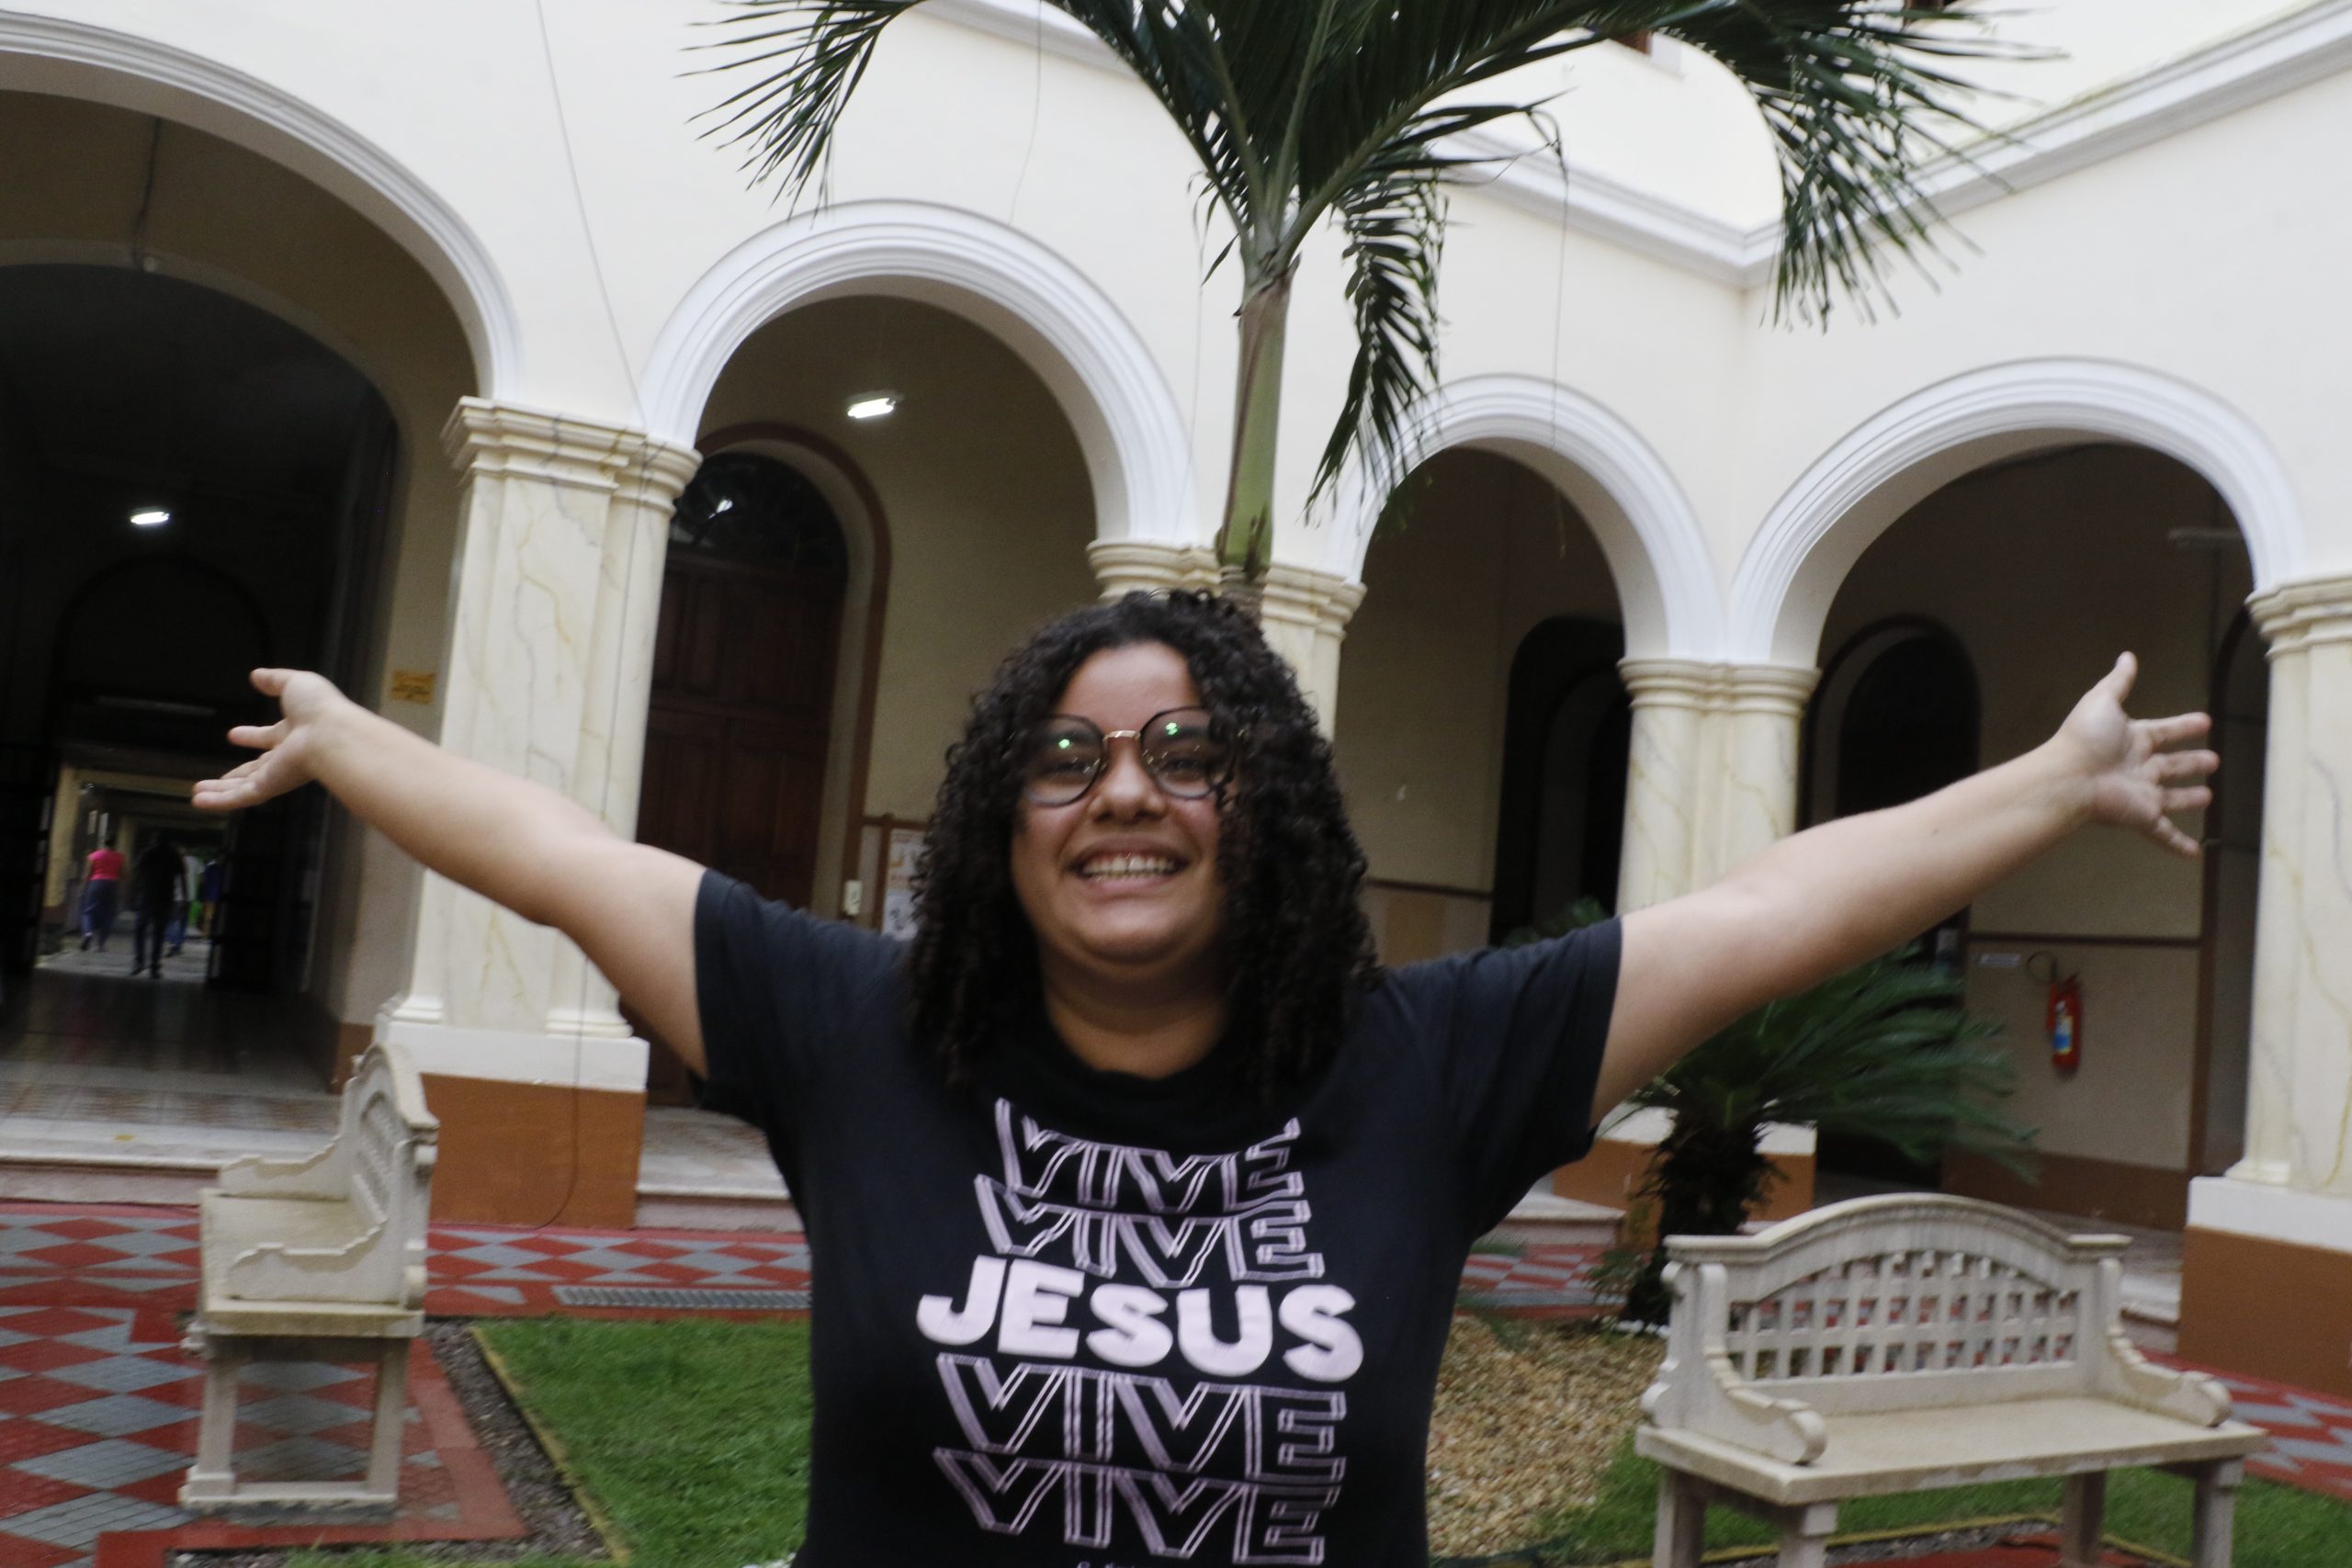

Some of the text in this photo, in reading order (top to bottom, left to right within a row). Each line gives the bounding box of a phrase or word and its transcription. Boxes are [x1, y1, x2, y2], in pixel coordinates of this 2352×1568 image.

[994, 1097, 1305, 1213] VIVE
[974, 1173, 1325, 1288] VIVE
[916, 1255, 1364, 1382] JESUS
[936, 1352, 1347, 1484] VIVE
[933, 1447, 1341, 1565] VIVE
